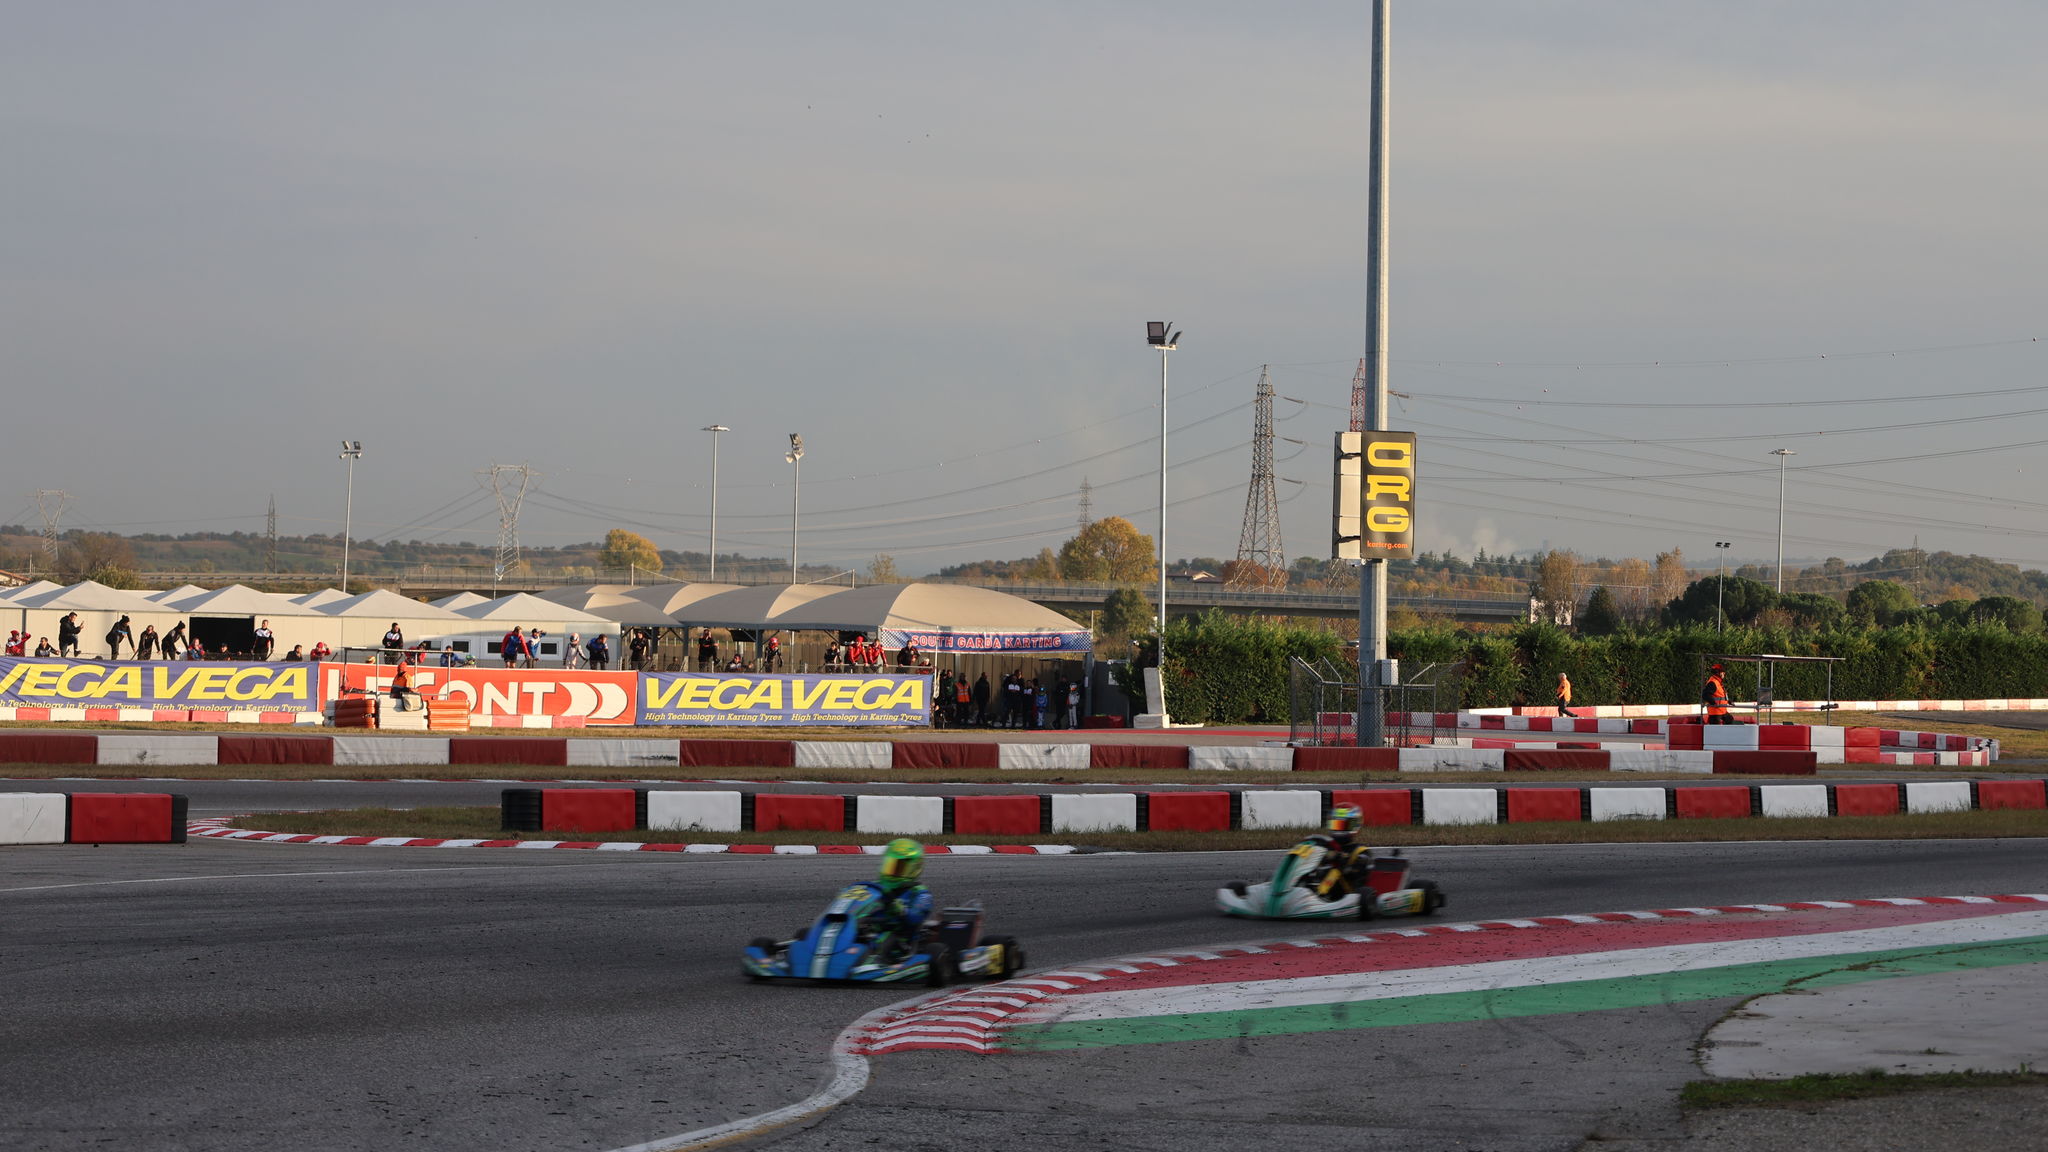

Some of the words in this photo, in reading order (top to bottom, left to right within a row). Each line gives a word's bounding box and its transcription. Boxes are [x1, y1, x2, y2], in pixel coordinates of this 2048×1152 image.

[1366, 441, 1411, 533] CRG
[911, 635, 953, 648] SOUTH
[957, 636, 1001, 649] GARDA
[1005, 637, 1062, 649] KARTING
[153, 666, 308, 701] VEGA
[646, 677, 783, 710] VEGA
[792, 678, 924, 710] VEGA
[177, 703, 232, 711] Technology
[246, 703, 279, 712] Karting
[281, 703, 307, 712] Tyres
[645, 712, 665, 722] High
[667, 712, 715, 722] Technology
[717, 712, 725, 721] in
[727, 713, 757, 722] Karting
[759, 713, 783, 722] Tyres
[791, 713, 811, 722] High
[813, 713, 859, 723] Technology
[860, 713, 869, 721] in
[869, 713, 899, 722] Karting
[900, 713, 923, 722] Tyres
